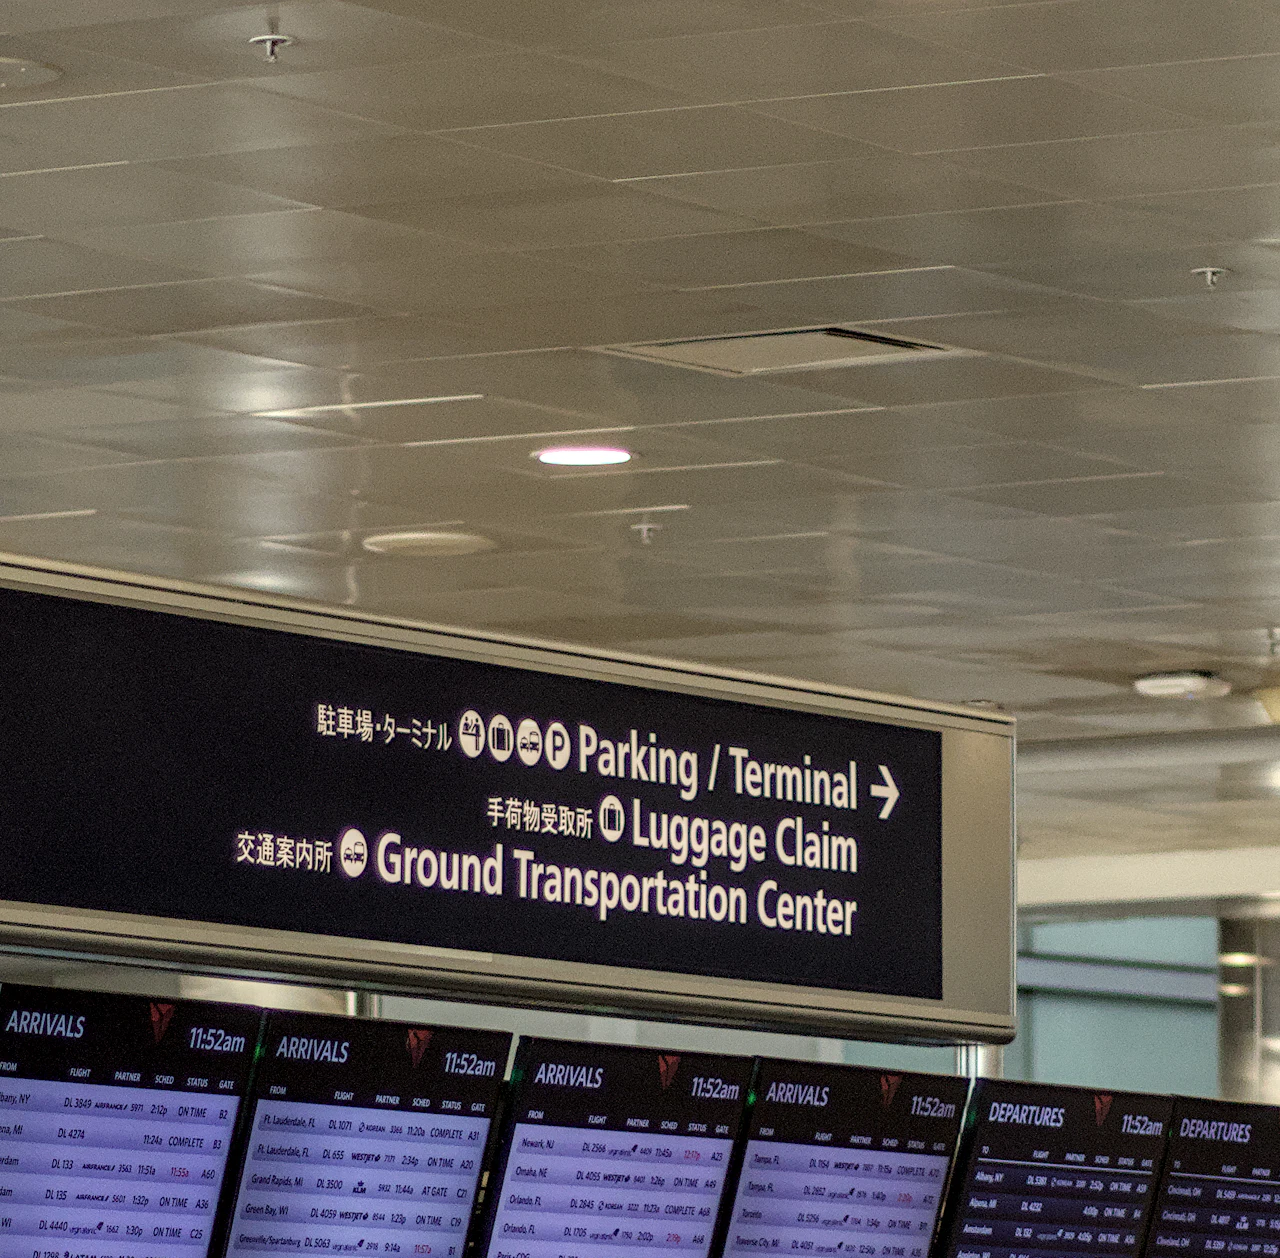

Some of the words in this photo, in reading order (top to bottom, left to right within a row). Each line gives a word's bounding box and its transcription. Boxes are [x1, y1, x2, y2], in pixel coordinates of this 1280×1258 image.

[579, 725, 697, 804] Parking
[708, 744, 720, 790] /
[729, 747, 857, 809] Terminal
[488, 797, 592, 839] 手荷物受取所
[633, 798, 765, 872] Luggage
[776, 817, 857, 872] Claim
[238, 831, 332, 873] 交通案内所
[377, 833, 503, 895] Ground
[513, 845, 747, 923] Transportation
[758, 880, 856, 935] Center
[6, 1010, 85, 1038] ARRIVALS
[190, 1028, 245, 1052] 11:52am
[276, 1036, 349, 1063] ARRIVALS
[445, 1052, 495, 1076] 11:52am
[0, 1061, 17, 1071] FROM
[70, 1068, 90, 1077] FLIGHT
[115, 1071, 140, 1081] PARTNER
[155, 1075, 174, 1084] SCHED
[187, 1077, 208, 1087] STATUS
[219, 1080, 234, 1089] GATE
[535, 1063, 603, 1088] ARRIVALS
[692, 1077, 739, 1099] 11:52am
[766, 1082, 829, 1106] ARRIVALS
[912, 1096, 955, 1117] 11:52am
[989, 1102, 1064, 1127] DEPARTURES
[1123, 1115, 1162, 1135] 11:52am
[1180, 1118, 1251, 1144] DEPARTURES
[58, 1128, 66, 1138] DL
[69, 1129, 85, 1139] 4274
[144, 1135, 162, 1145] 11:24a
[169, 1136, 203, 1148] COMPLETE
[51, 1158, 60, 1169] DL
[63, 1160, 74, 1170] 133
[246, 1203, 263, 1213] Green
[311, 1208, 318, 1218] DL
[320, 1209, 336, 1219] 4059
[416, 1215, 425, 1224] ON
[428, 1215, 442, 1226] TIME
